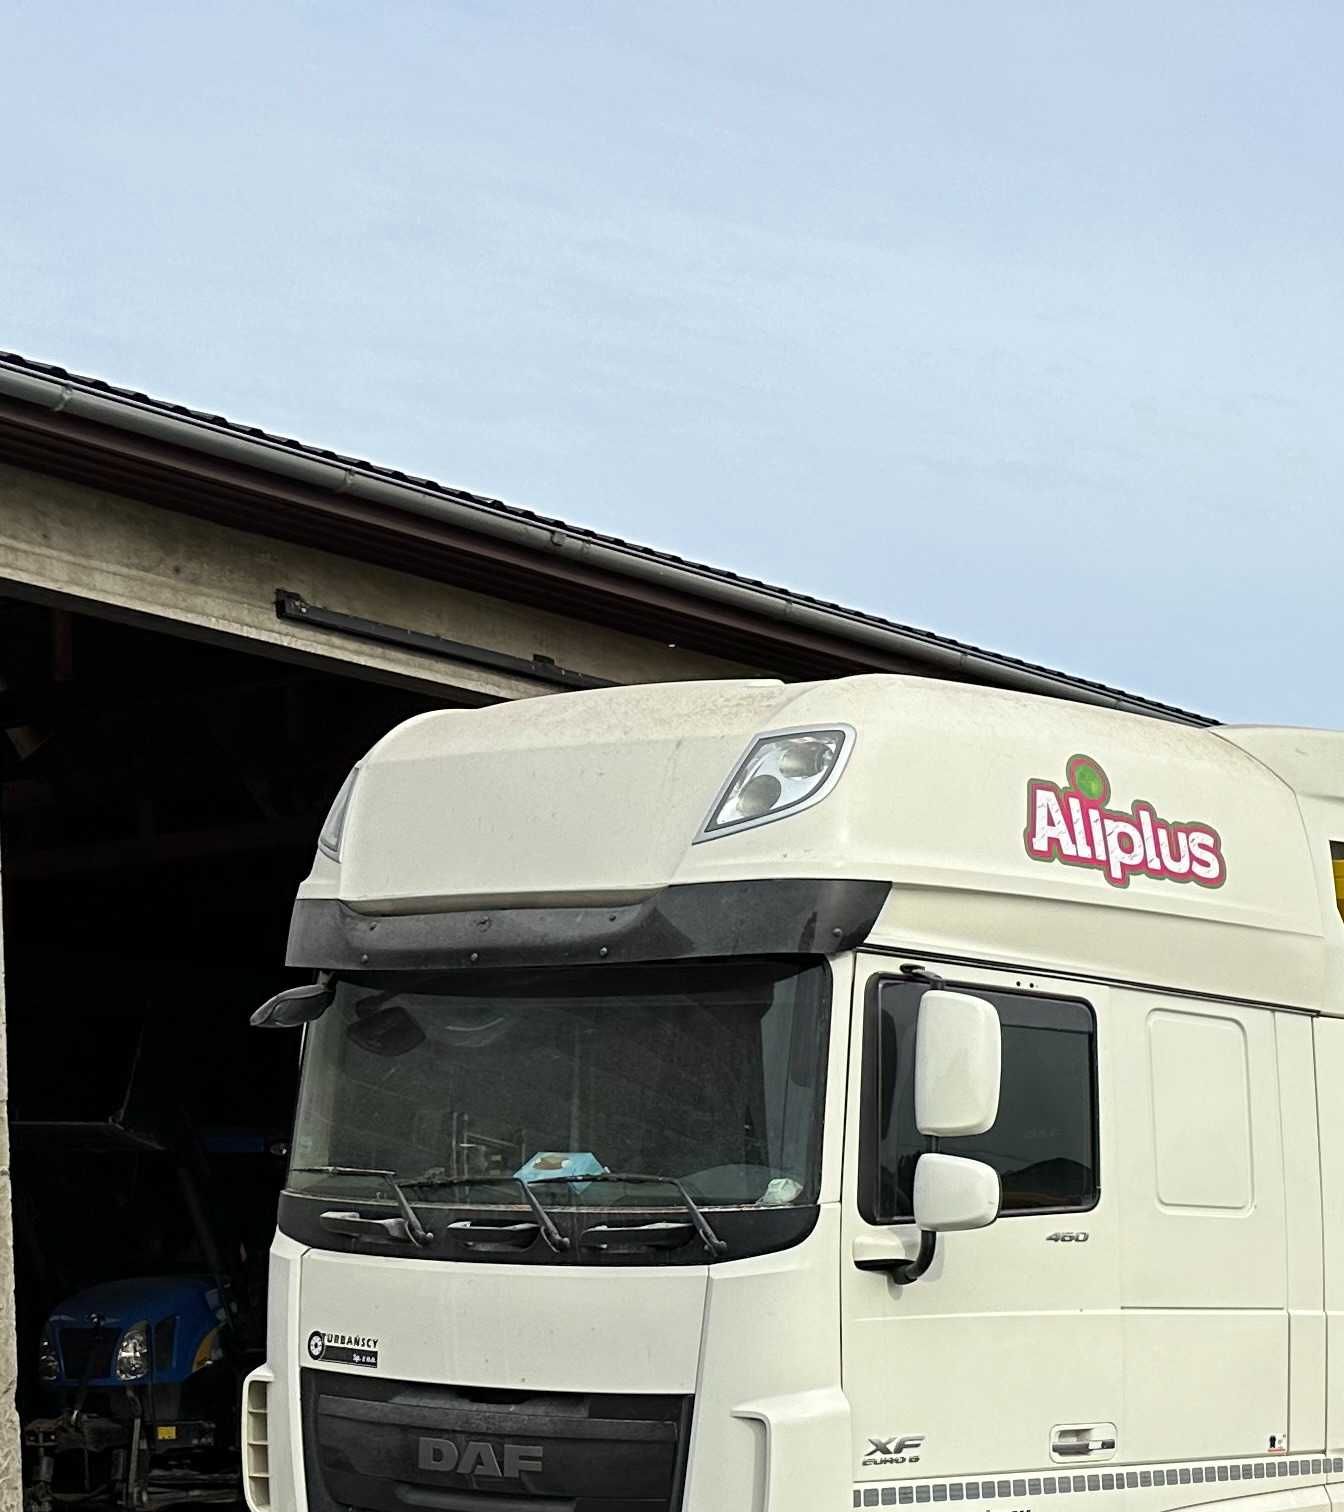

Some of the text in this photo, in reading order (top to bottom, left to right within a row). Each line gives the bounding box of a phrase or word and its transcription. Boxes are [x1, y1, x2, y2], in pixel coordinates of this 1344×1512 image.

[1030, 764, 1221, 880] Aliplus
[1045, 1231, 1090, 1243] 460
[320, 1333, 379, 1349] TURBAŃSCY
[863, 1435, 927, 1457] XF
[416, 1436, 545, 1479] DAF
